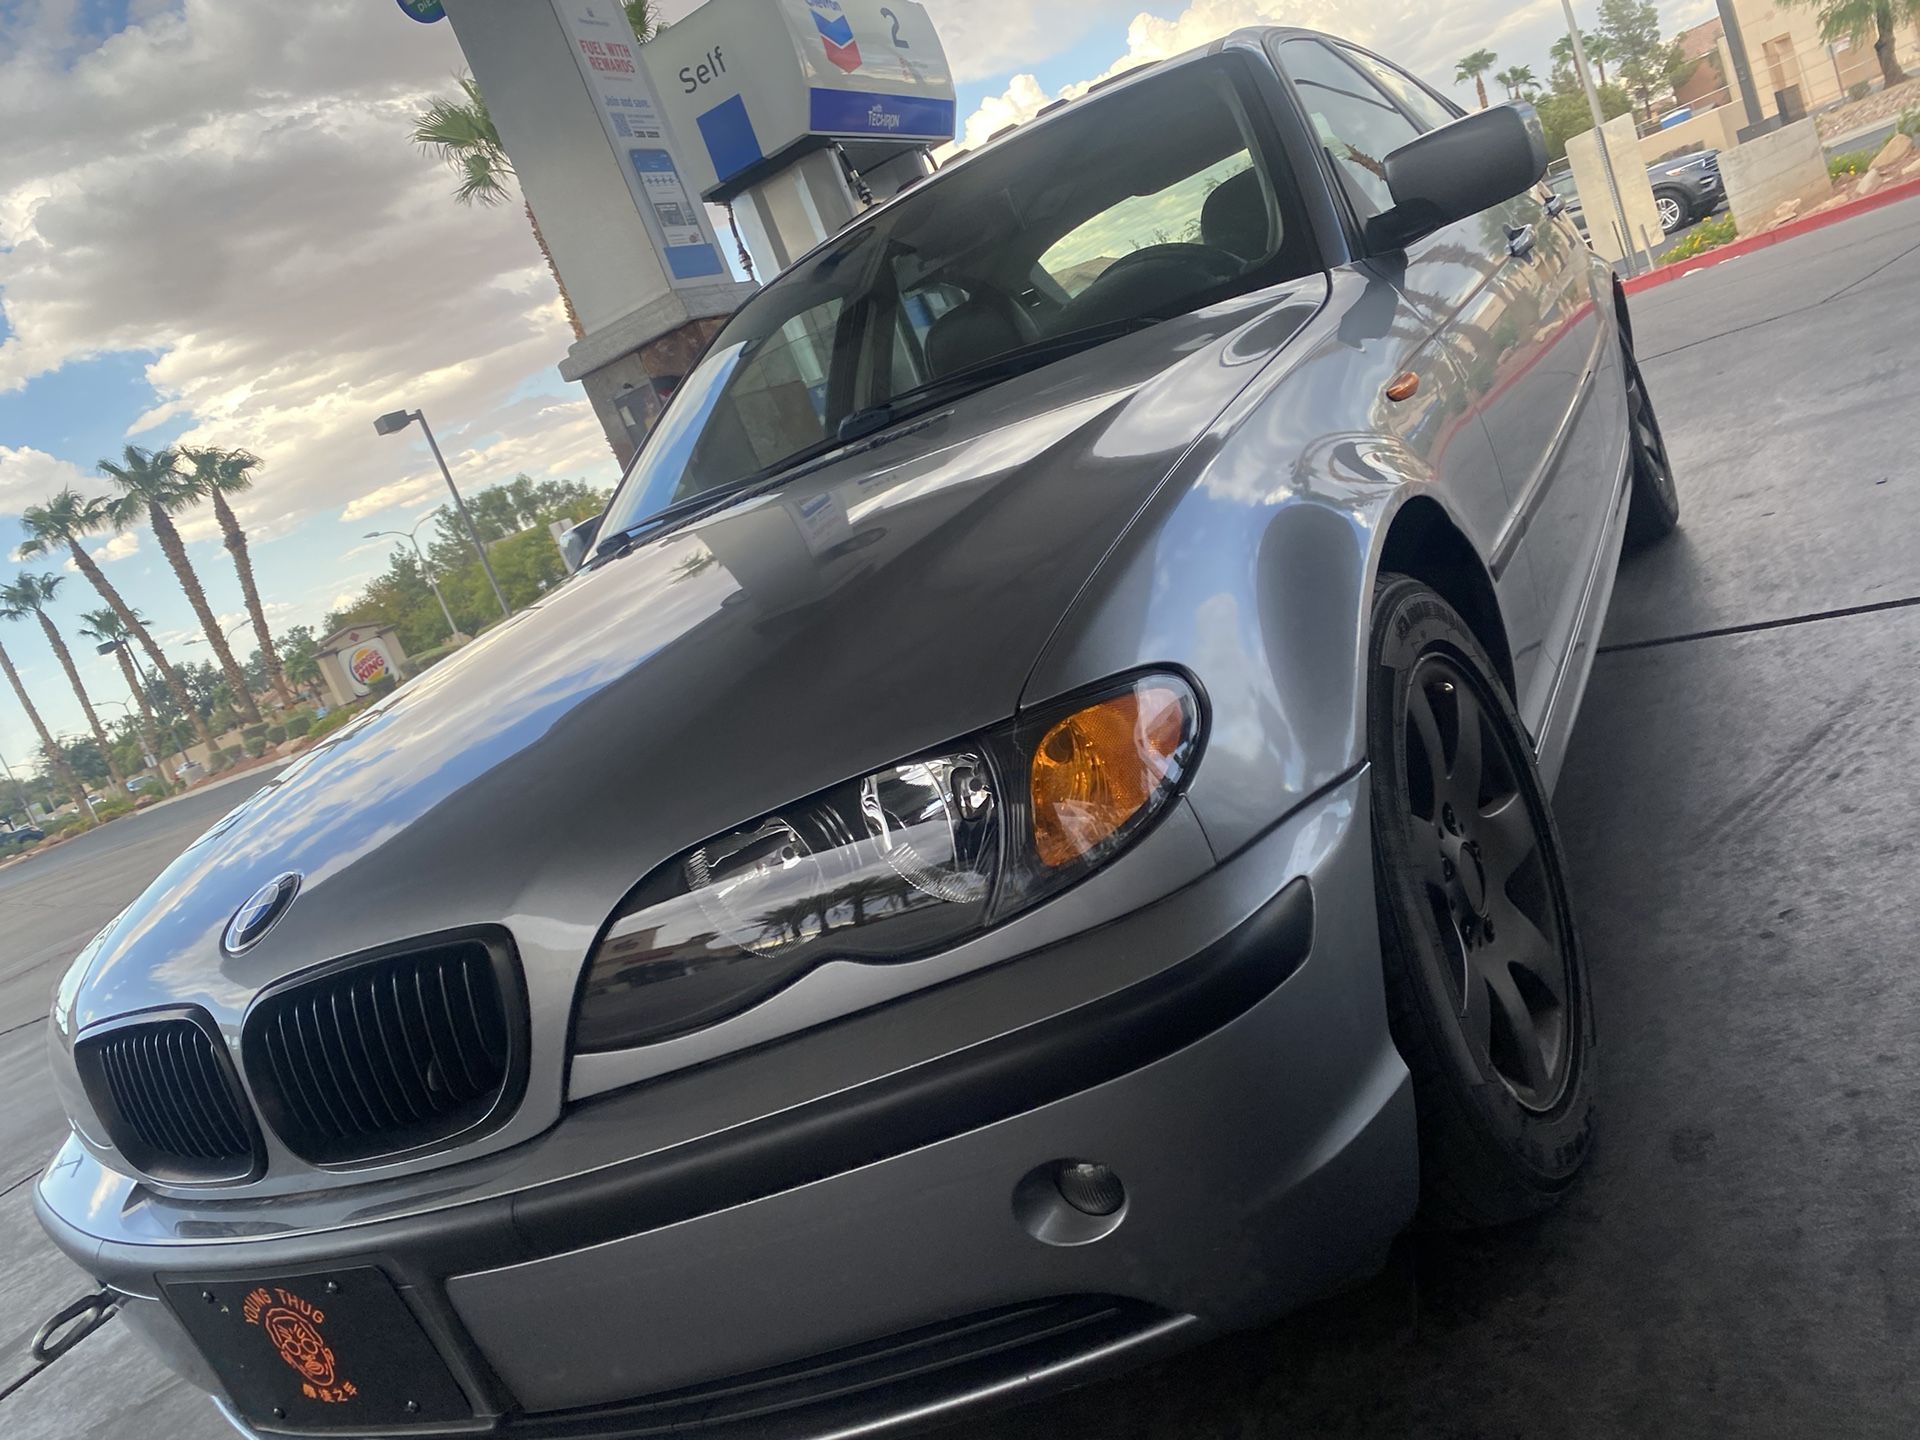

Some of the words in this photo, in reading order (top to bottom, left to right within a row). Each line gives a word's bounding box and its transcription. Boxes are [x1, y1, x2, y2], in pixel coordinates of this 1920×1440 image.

[880, 7, 910, 49] 2
[579, 40, 606, 56] FUEL
[605, 42, 632, 58] WITH
[588, 56, 635, 73] REWARDS
[679, 45, 726, 94] Self
[867, 110, 901, 130] TECHRON
[358, 656, 385, 683] KING
[243, 1287, 272, 1325] YOUNG
[273, 1287, 325, 1324] THUG
